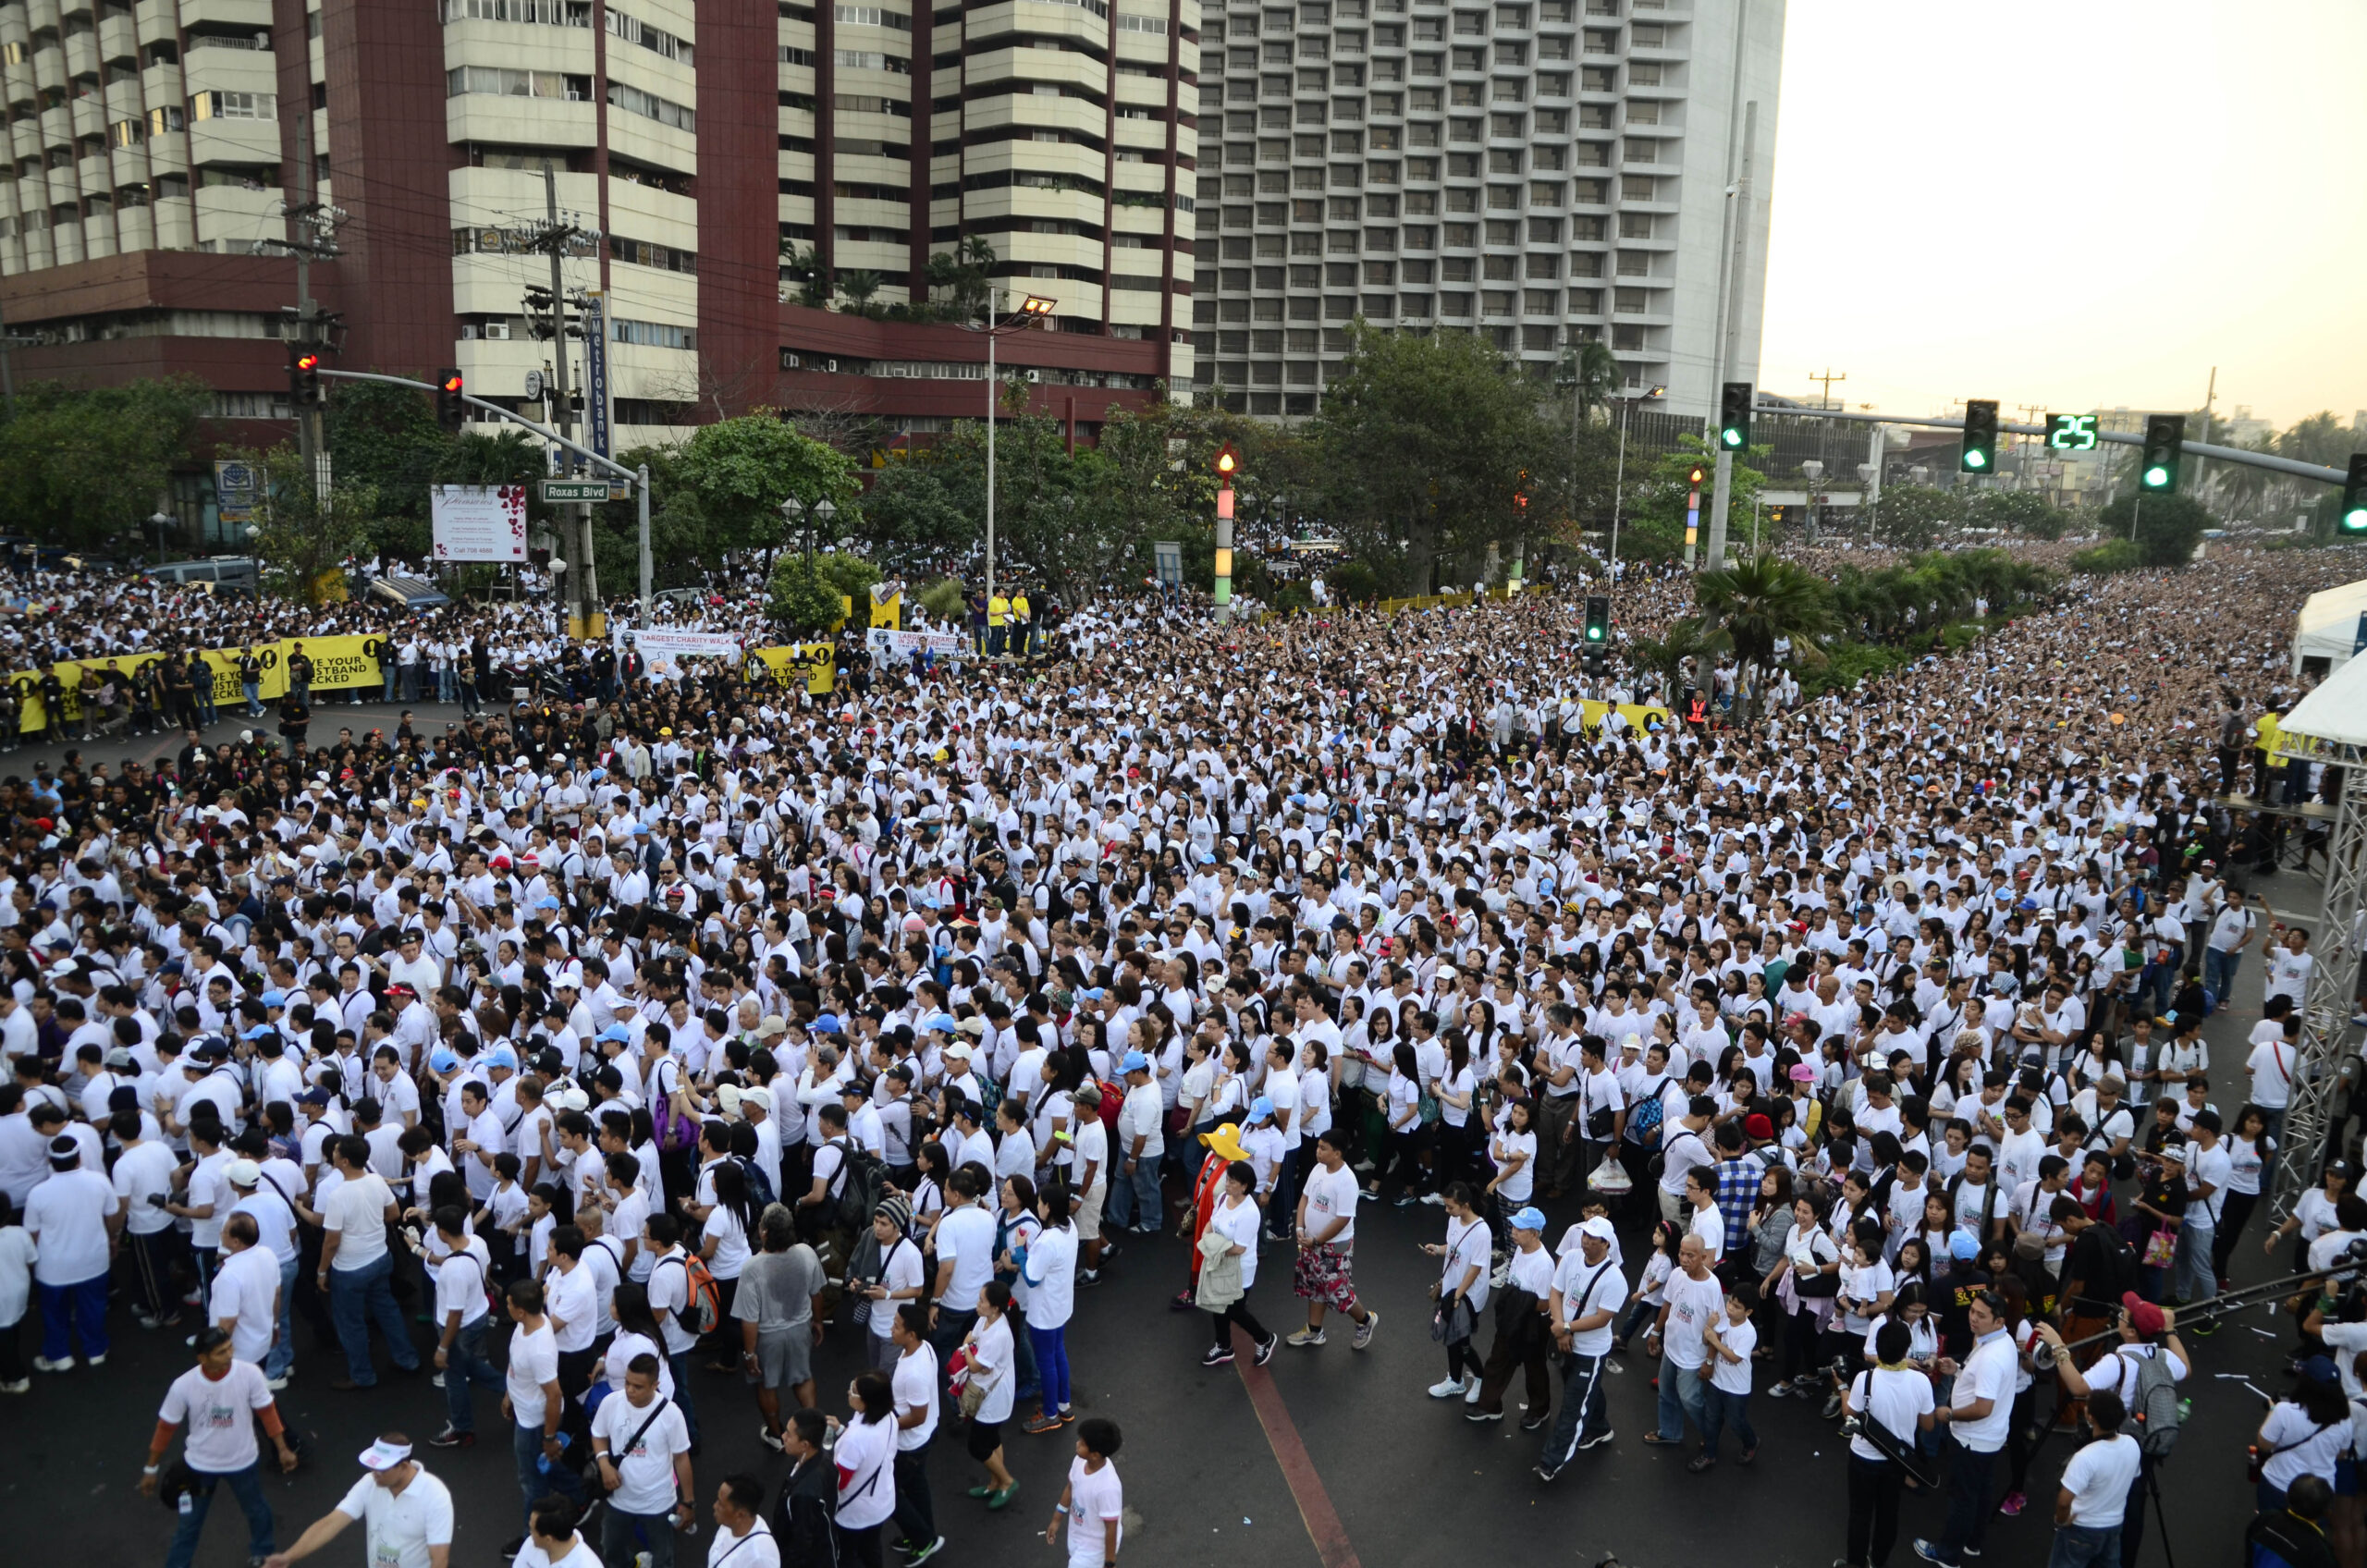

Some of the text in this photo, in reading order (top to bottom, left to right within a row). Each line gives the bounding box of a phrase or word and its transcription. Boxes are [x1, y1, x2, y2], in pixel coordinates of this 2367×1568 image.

[592, 320, 605, 449] Metrobank
[2052, 415, 2096, 449] 25
[548, 486, 605, 497] Roxas Blvd
[642, 635, 730, 645] LARGEST CHARITY WALK
[327, 656, 362, 666] YOUR
[782, 665, 813, 676] YOR
[213, 672, 226, 681] VE
[310, 674, 350, 684] ECKED
[213, 689, 243, 700] ECKE
